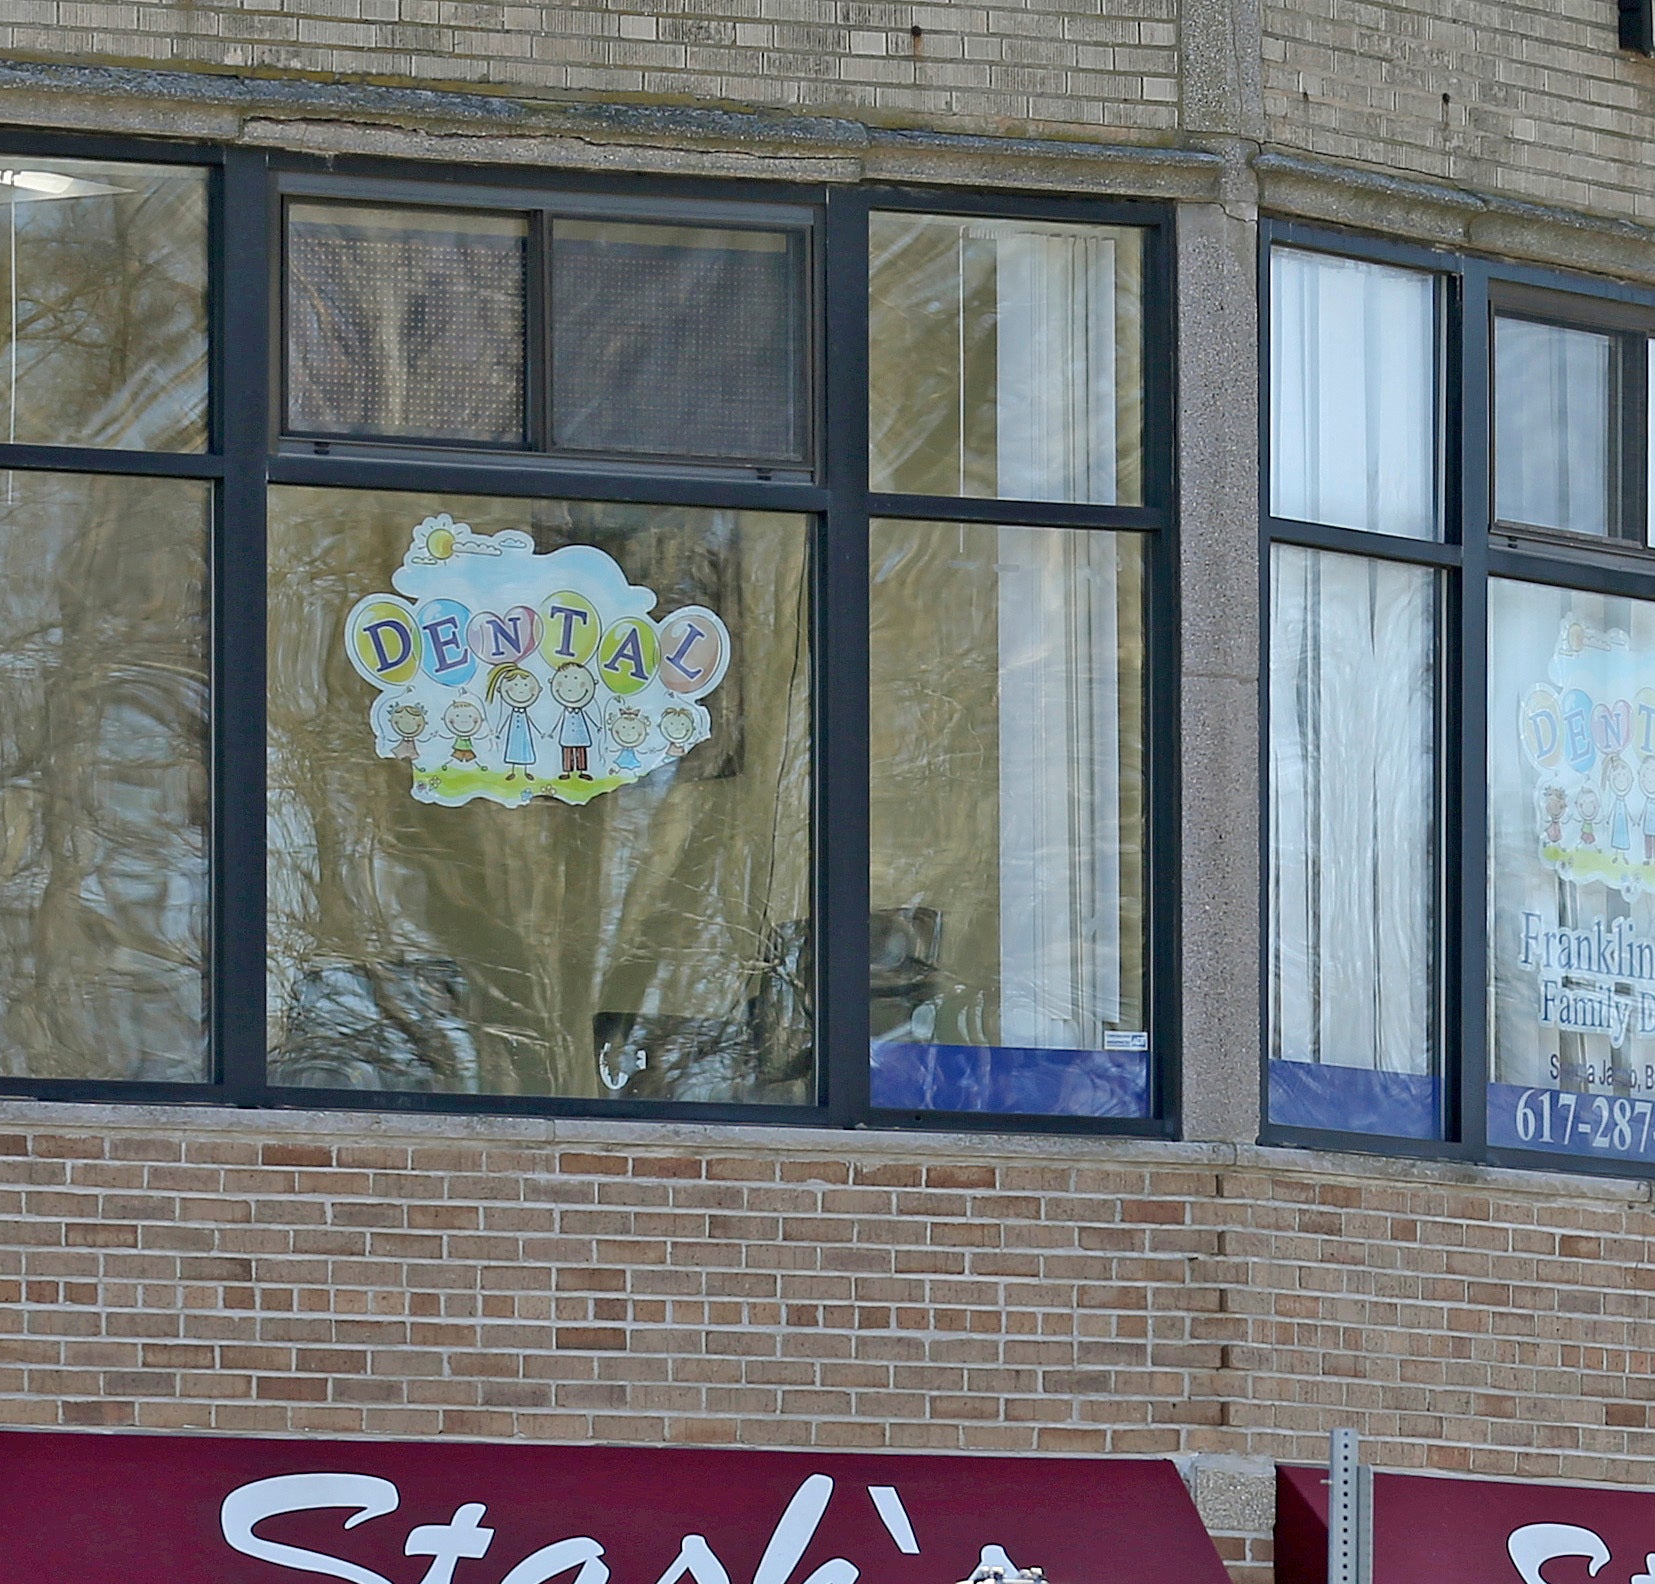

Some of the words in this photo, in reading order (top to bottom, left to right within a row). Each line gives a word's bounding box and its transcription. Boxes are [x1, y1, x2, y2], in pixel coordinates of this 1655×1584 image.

[363, 605, 706, 682] DENTAL
[1521, 911, 1655, 981] Franklin
[1542, 979, 1630, 1043] Family
